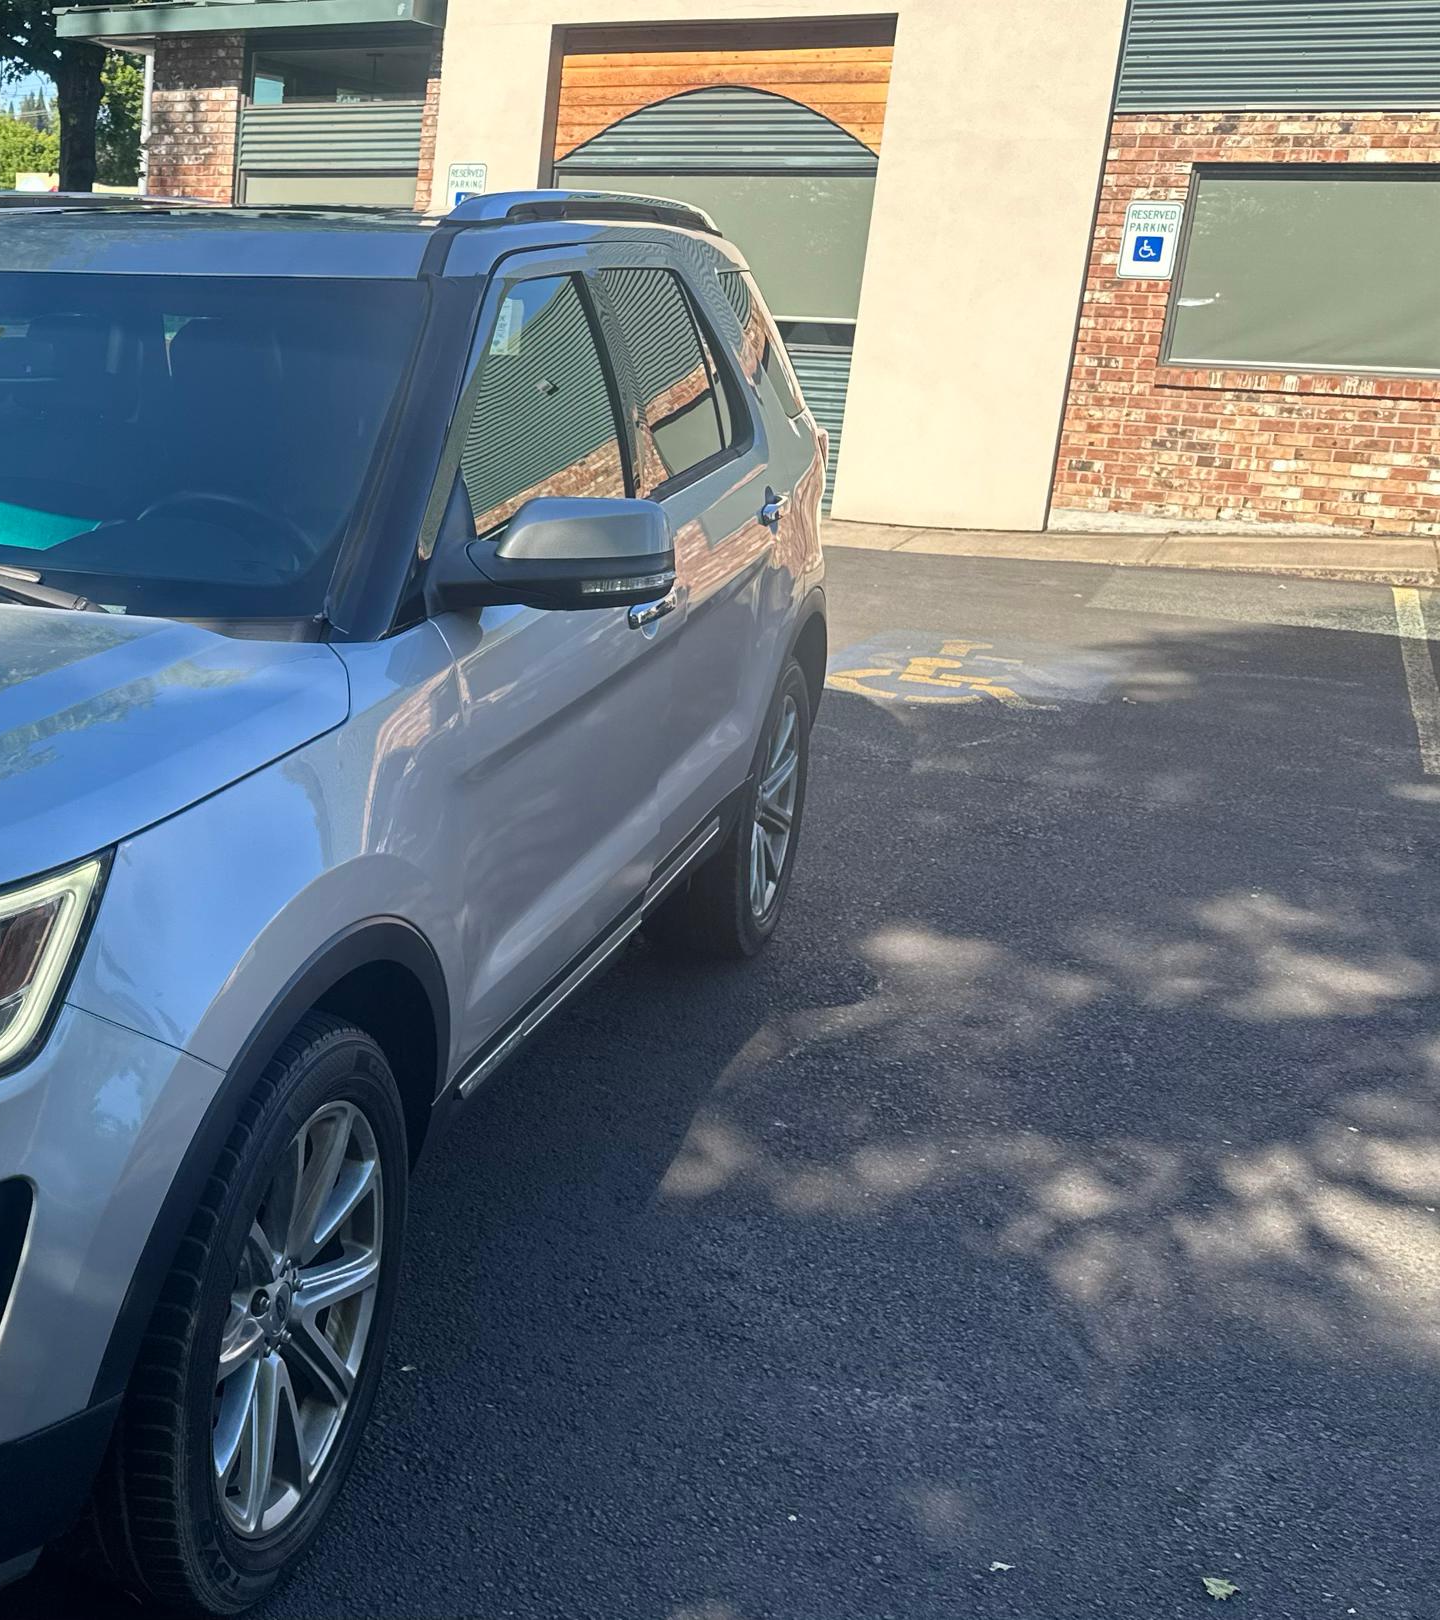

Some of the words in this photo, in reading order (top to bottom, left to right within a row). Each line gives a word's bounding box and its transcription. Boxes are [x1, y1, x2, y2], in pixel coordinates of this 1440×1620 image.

[451, 168, 484, 178] RESERVED
[450, 180, 483, 189] PARKING
[1131, 210, 1177, 220] RESERVED
[1129, 223, 1174, 233] PARKING
